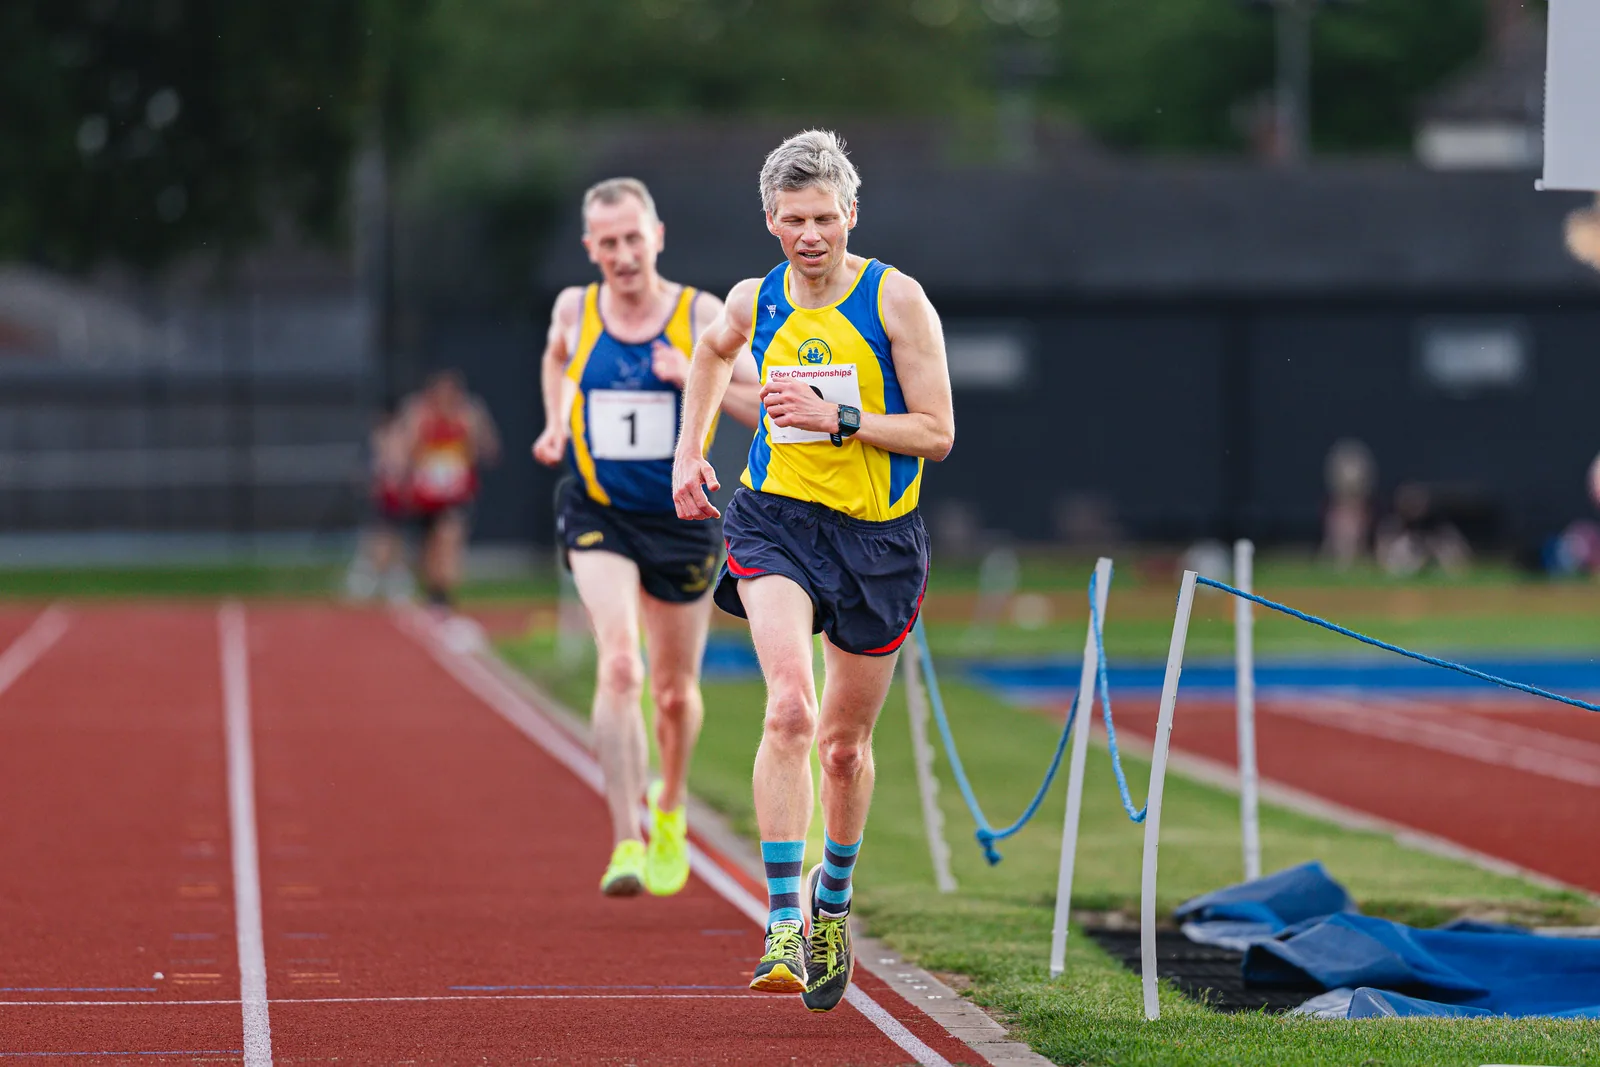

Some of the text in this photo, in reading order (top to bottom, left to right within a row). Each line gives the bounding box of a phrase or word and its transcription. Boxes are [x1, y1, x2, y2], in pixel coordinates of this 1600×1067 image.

[791, 369, 852, 379] Championships
[620, 410, 637, 446] 1
[805, 964, 846, 993] BROOKS
